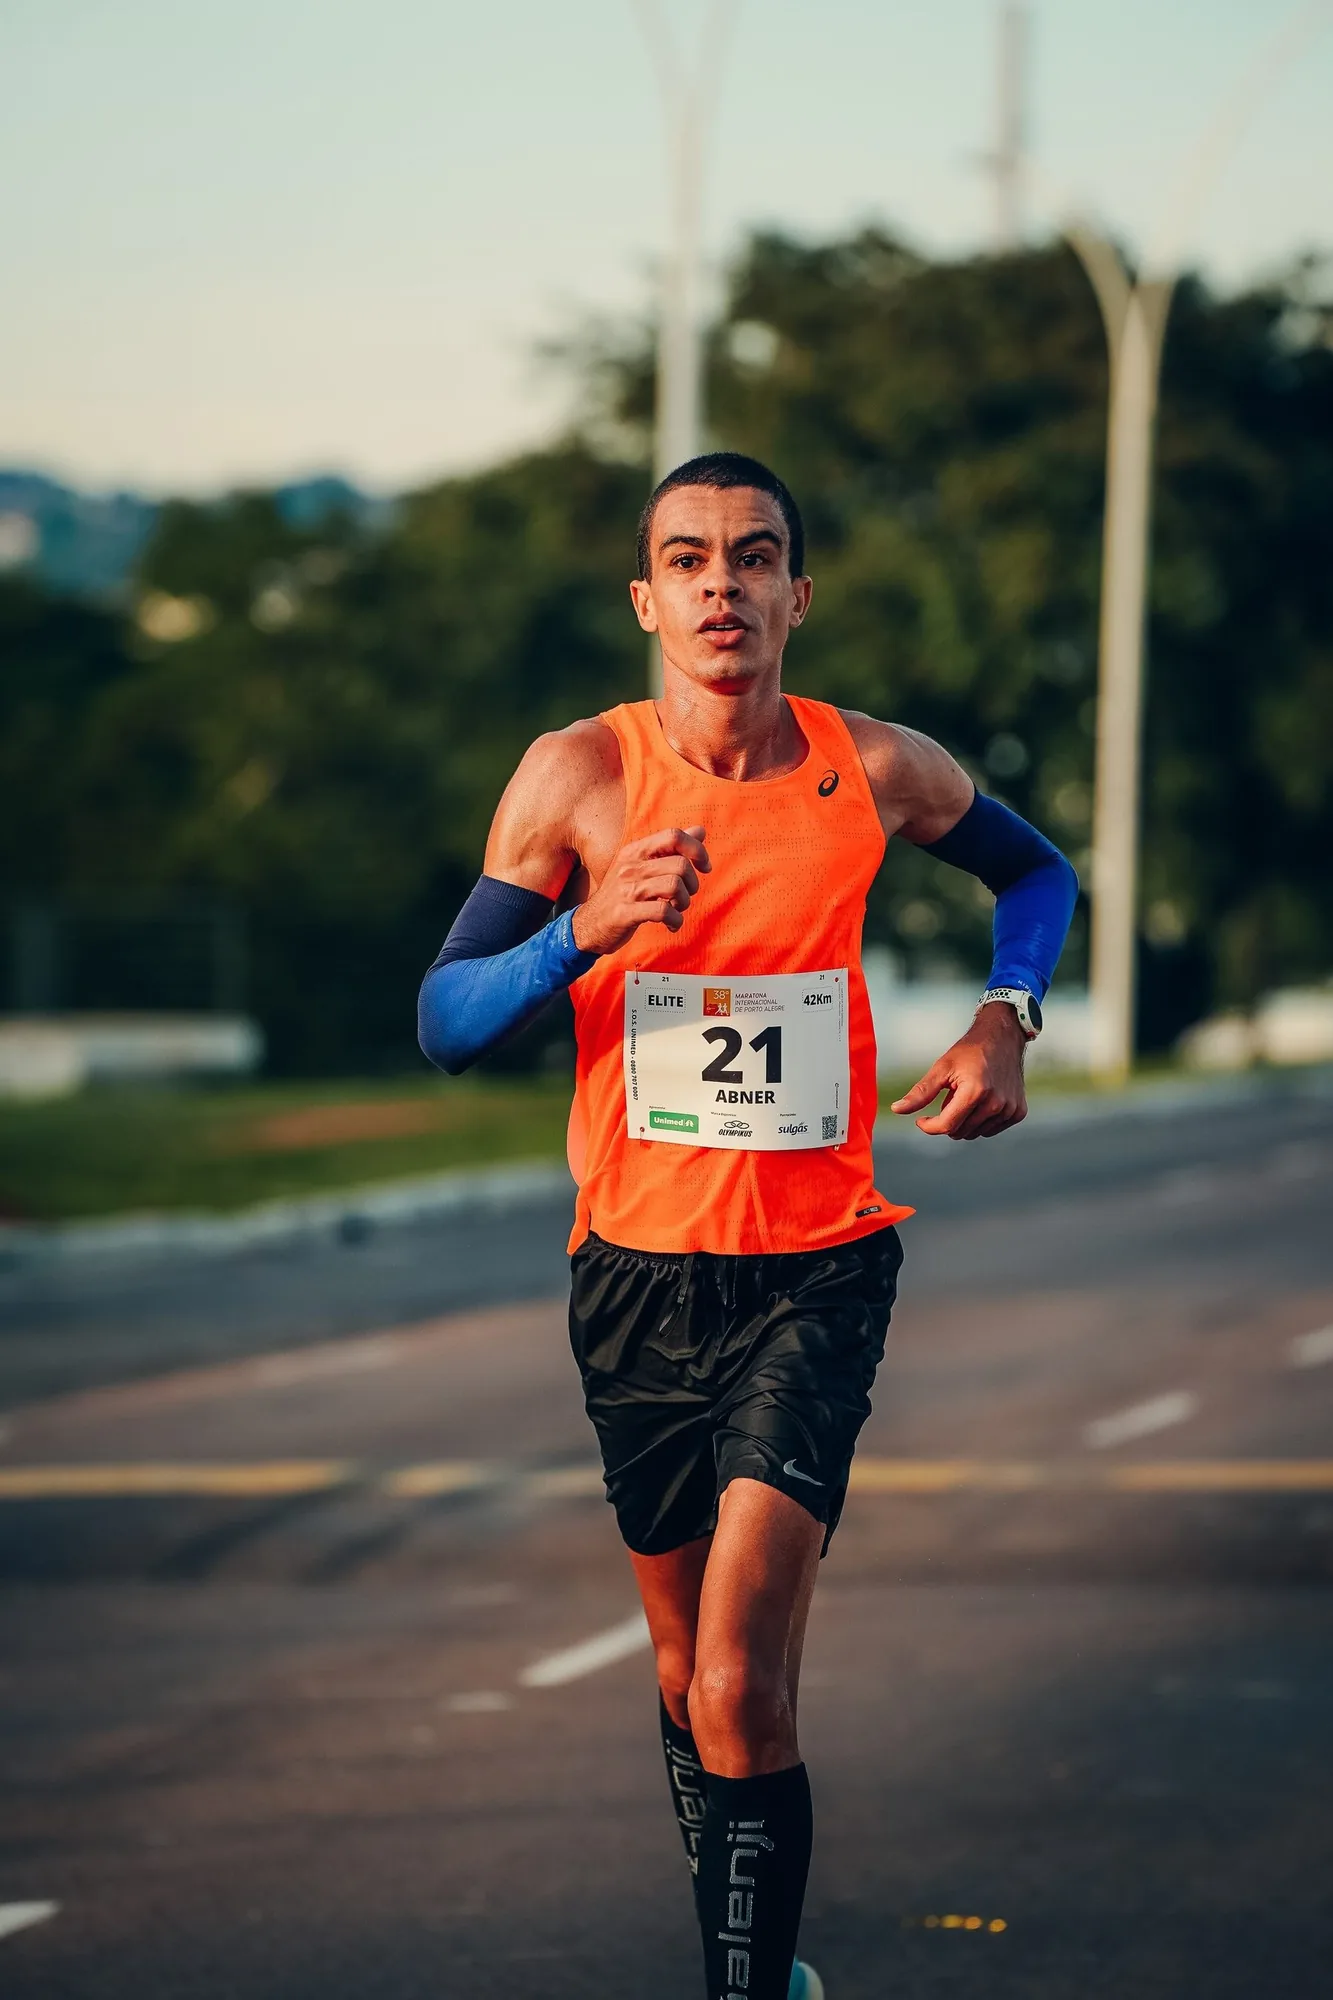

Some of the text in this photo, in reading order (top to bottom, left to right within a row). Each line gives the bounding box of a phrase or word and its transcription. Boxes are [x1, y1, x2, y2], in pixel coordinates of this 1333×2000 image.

[648, 994, 684, 1007] ELITE
[803, 993, 832, 1006] 42Km
[702, 1026, 782, 1084] 21
[715, 1089, 776, 1104] ABNER
[653, 1116, 684, 1126] Unimed
[718, 1128, 753, 1138] OLYMPIKUS
[777, 1122, 809, 1136] sulgás
[718, 1820, 774, 2000] alenji
